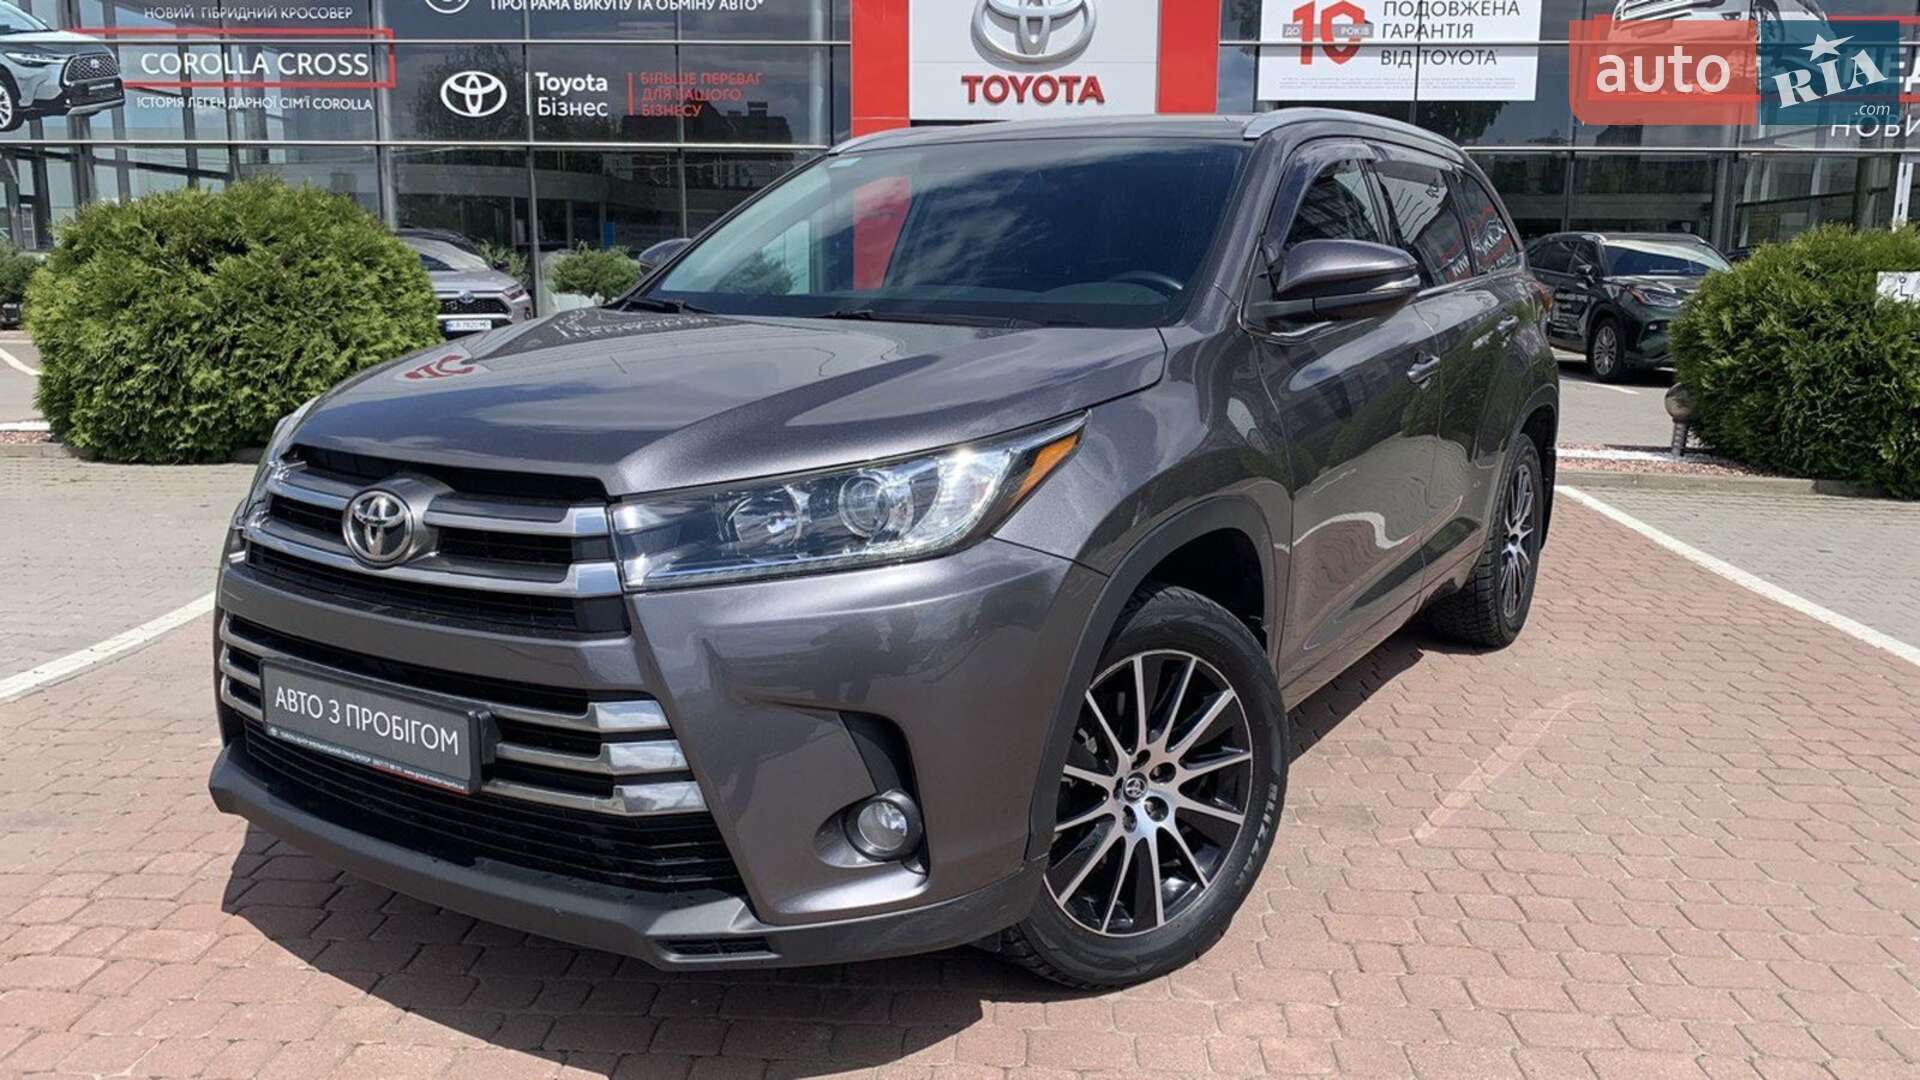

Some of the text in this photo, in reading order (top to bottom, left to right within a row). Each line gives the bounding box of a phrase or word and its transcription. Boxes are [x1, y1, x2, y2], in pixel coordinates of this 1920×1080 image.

[144, 5, 353, 20] НОВИЙ ГІБРИДНИЙ КРОСОВЕР
[1383, 1, 1520, 19] ПОДОВЖЕНА
[1293, 0, 1365, 65] 10
[1382, 24, 1473, 39] ГАРАНТІЯ
[141, 53, 369, 76] COROLLA CROSS
[1381, 50, 1412, 67] ВІД
[535, 72, 608, 97] Toyota
[640, 72, 763, 85] БІЛЬШЕ ПЕРЕВАГ
[961, 75, 1105, 105] TOYOTA
[137, 96, 184, 108] ІСТОРІЯ
[313, 99, 372, 111] COROLLA
[538, 97, 608, 117] Бізнес
[641, 103, 704, 117] БІЗНЕСУ
[275, 686, 459, 756] АВТО З ПРОБІГОМ
